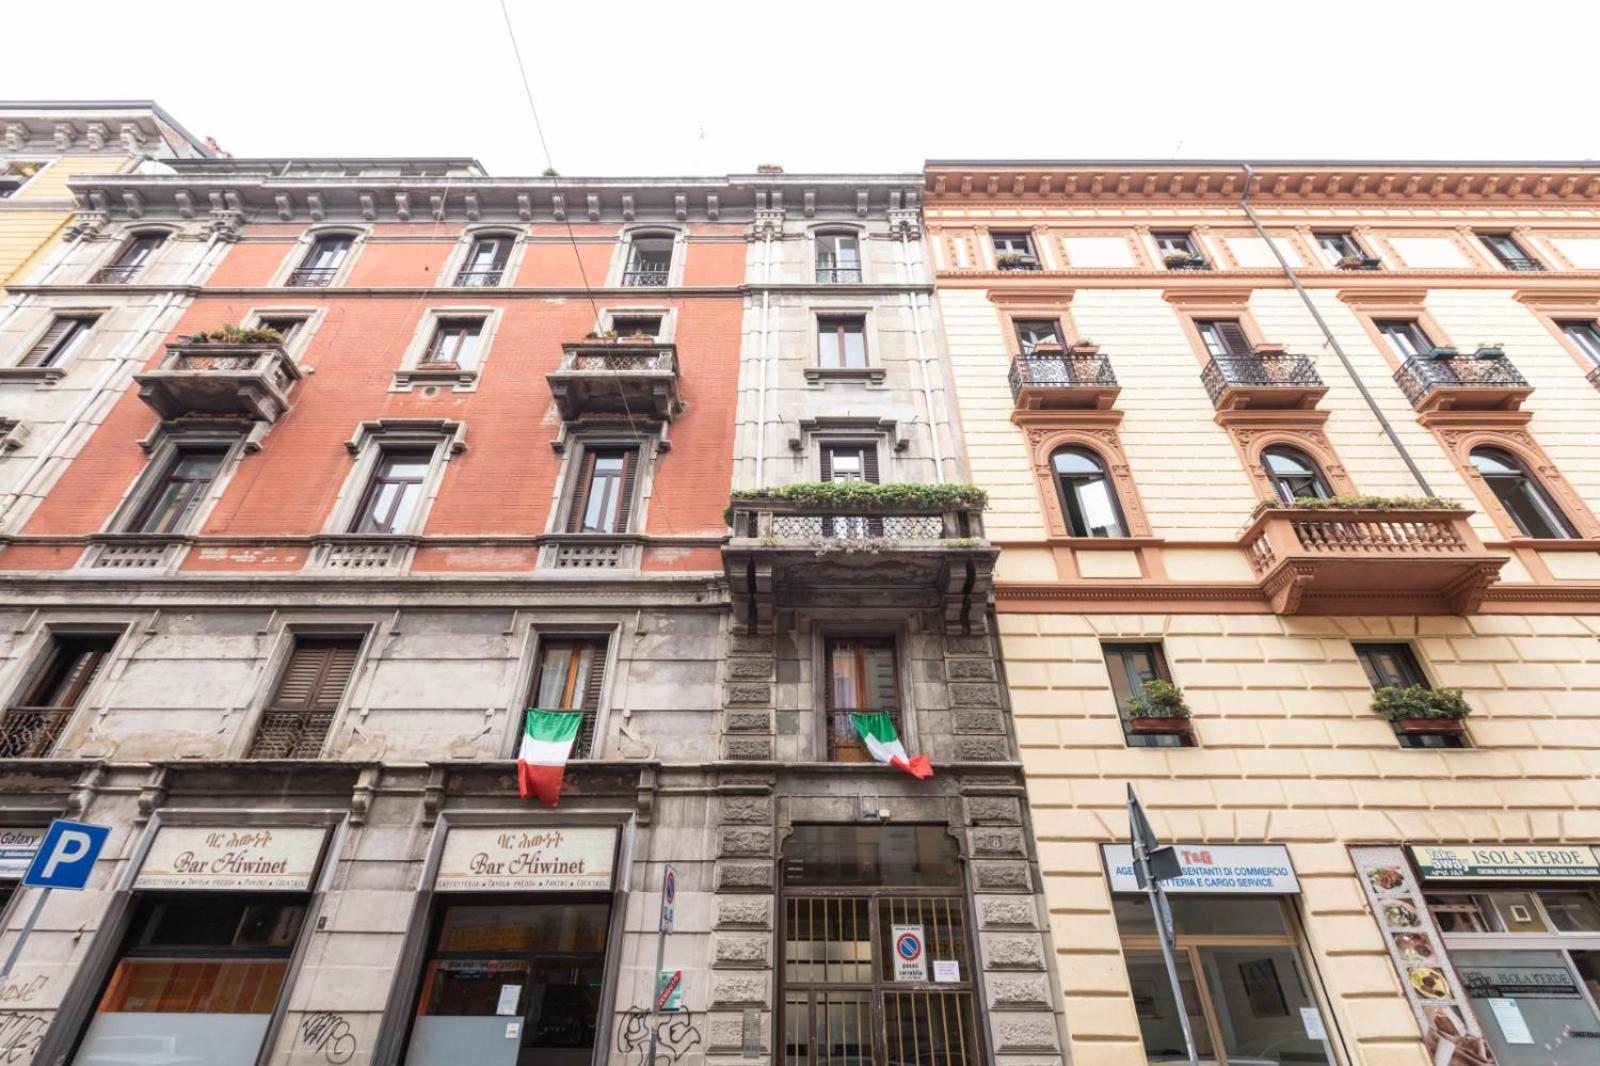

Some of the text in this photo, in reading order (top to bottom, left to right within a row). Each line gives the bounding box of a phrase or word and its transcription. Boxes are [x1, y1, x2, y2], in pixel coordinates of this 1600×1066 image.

[1, 831, 36, 847] Galaxy
[41, 829, 92, 878] P
[174, 849, 288, 874] Bar Hiwinet
[1472, 849, 1584, 864] ISOLA VERDE
[470, 850, 585, 875] Bar Hiwinet
[1224, 867, 1233, 876] DI
[1235, 867, 1288, 876] COMMERCIO
[1205, 878, 1235, 887] CARGO
[1238, 878, 1274, 887] SERVICE
